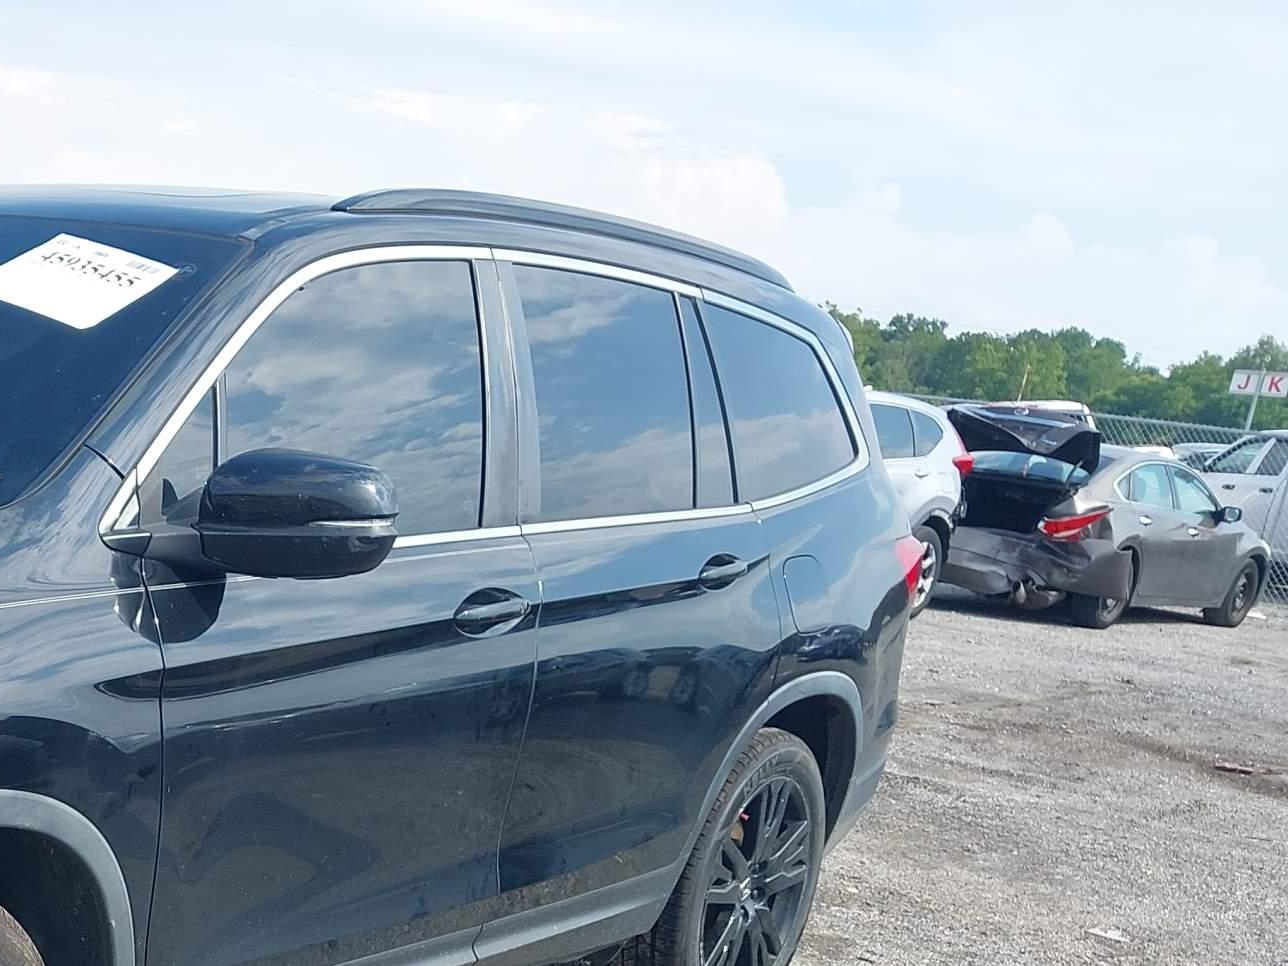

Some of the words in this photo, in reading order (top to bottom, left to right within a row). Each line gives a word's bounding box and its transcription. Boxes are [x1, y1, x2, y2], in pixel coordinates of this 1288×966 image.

[40, 251, 143, 288] 45935455
[1237, 374, 1251, 390] J
[1268, 376, 1284, 392] K
